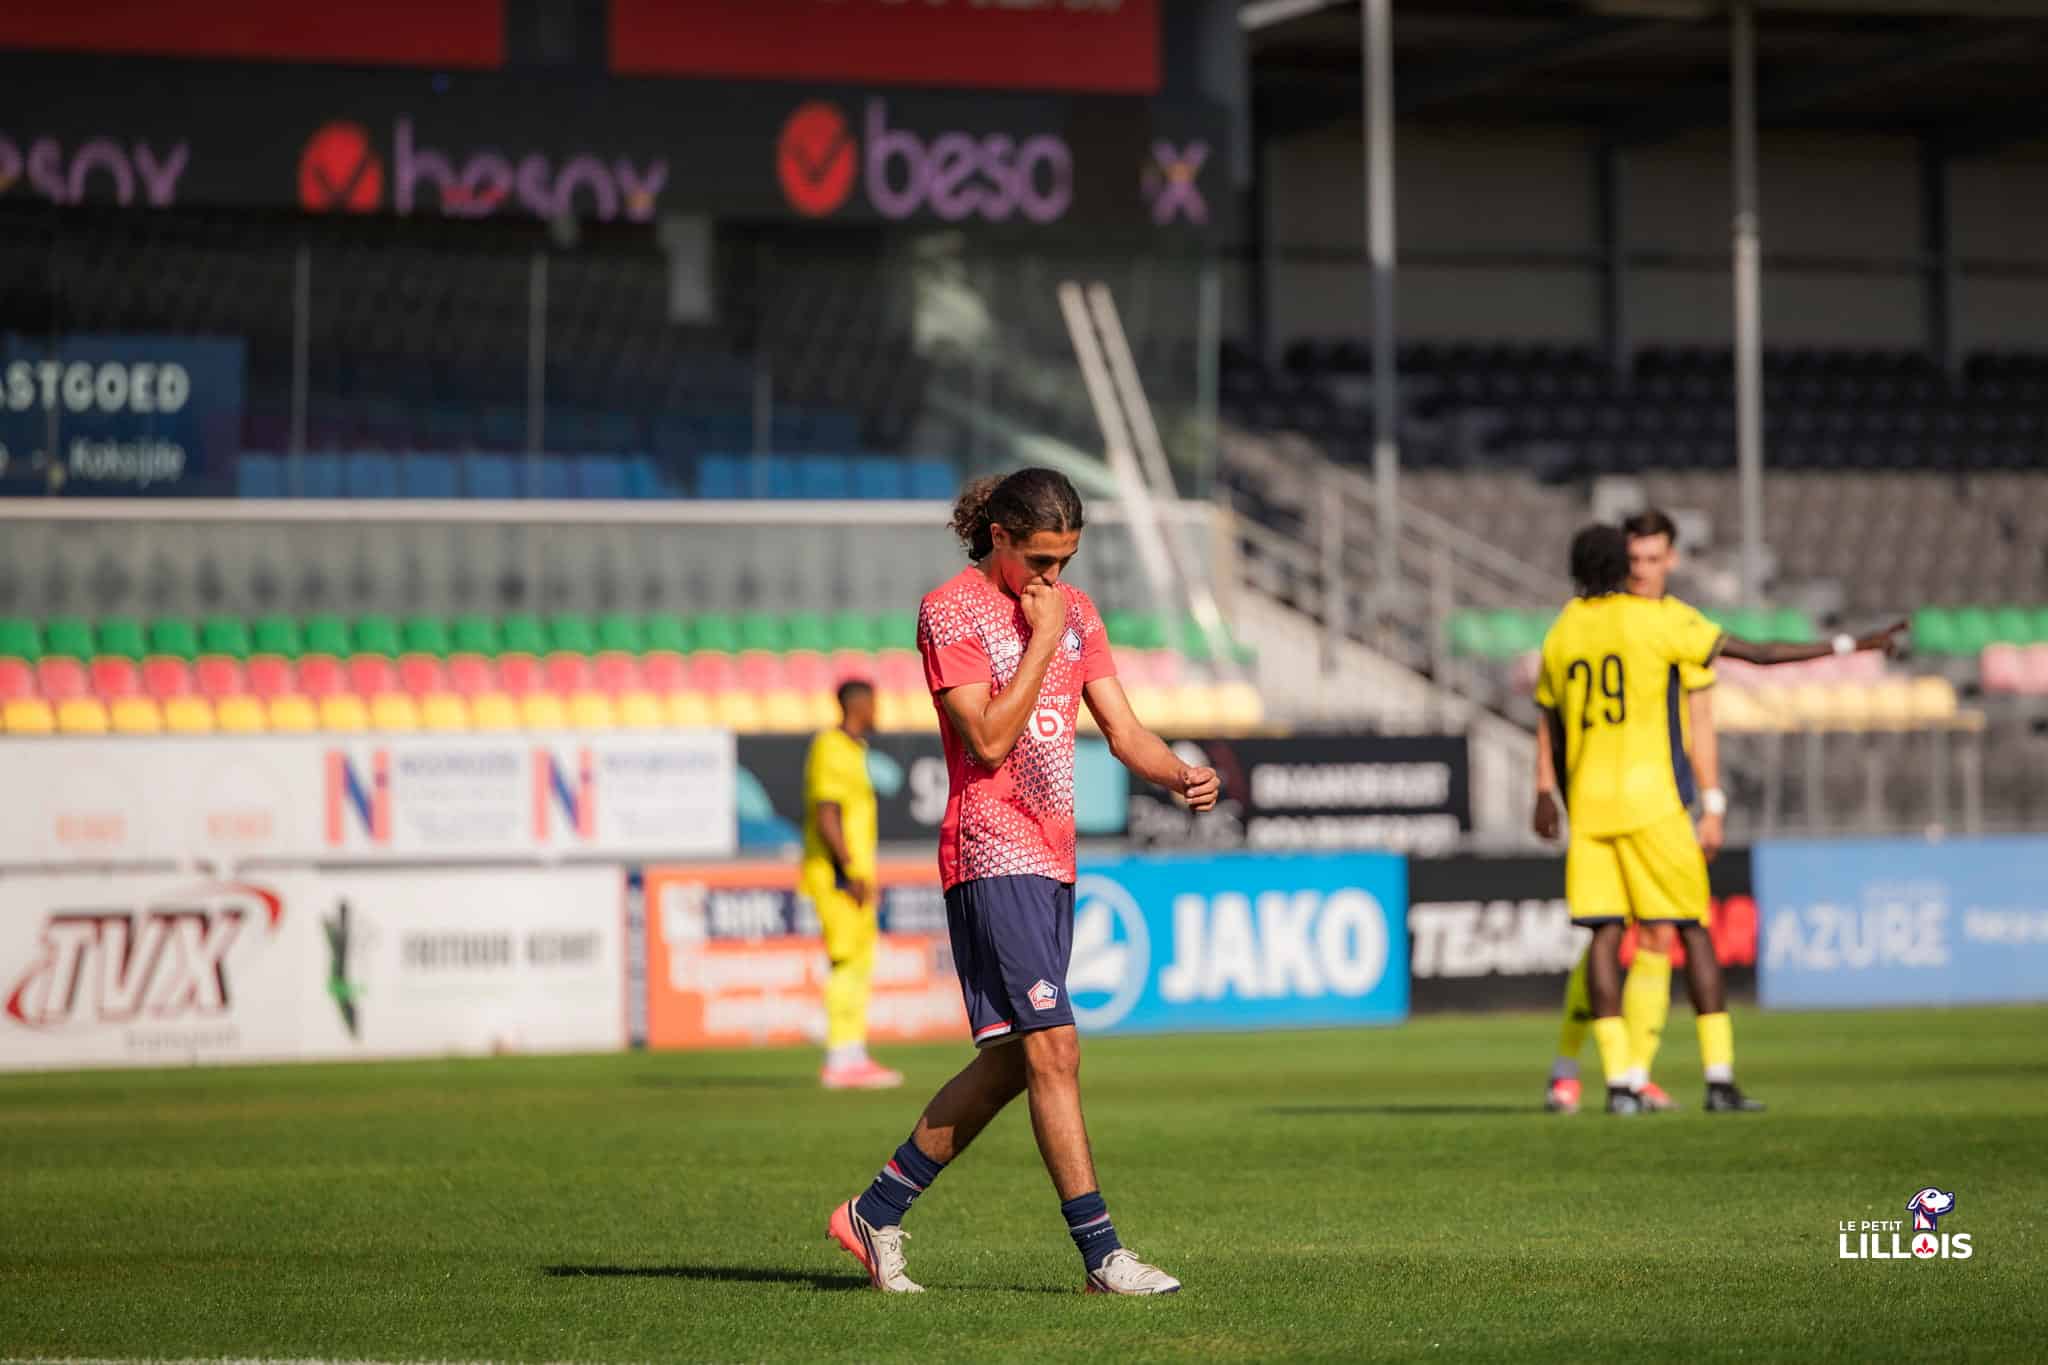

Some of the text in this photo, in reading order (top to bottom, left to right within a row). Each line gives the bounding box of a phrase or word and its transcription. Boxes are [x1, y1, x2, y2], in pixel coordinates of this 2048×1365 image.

[0, 359, 191, 414] STGOED
[1568, 653, 1625, 731] 29
[1158, 887, 1388, 1000] JAKO
[1766, 901, 1950, 969] AZURE
